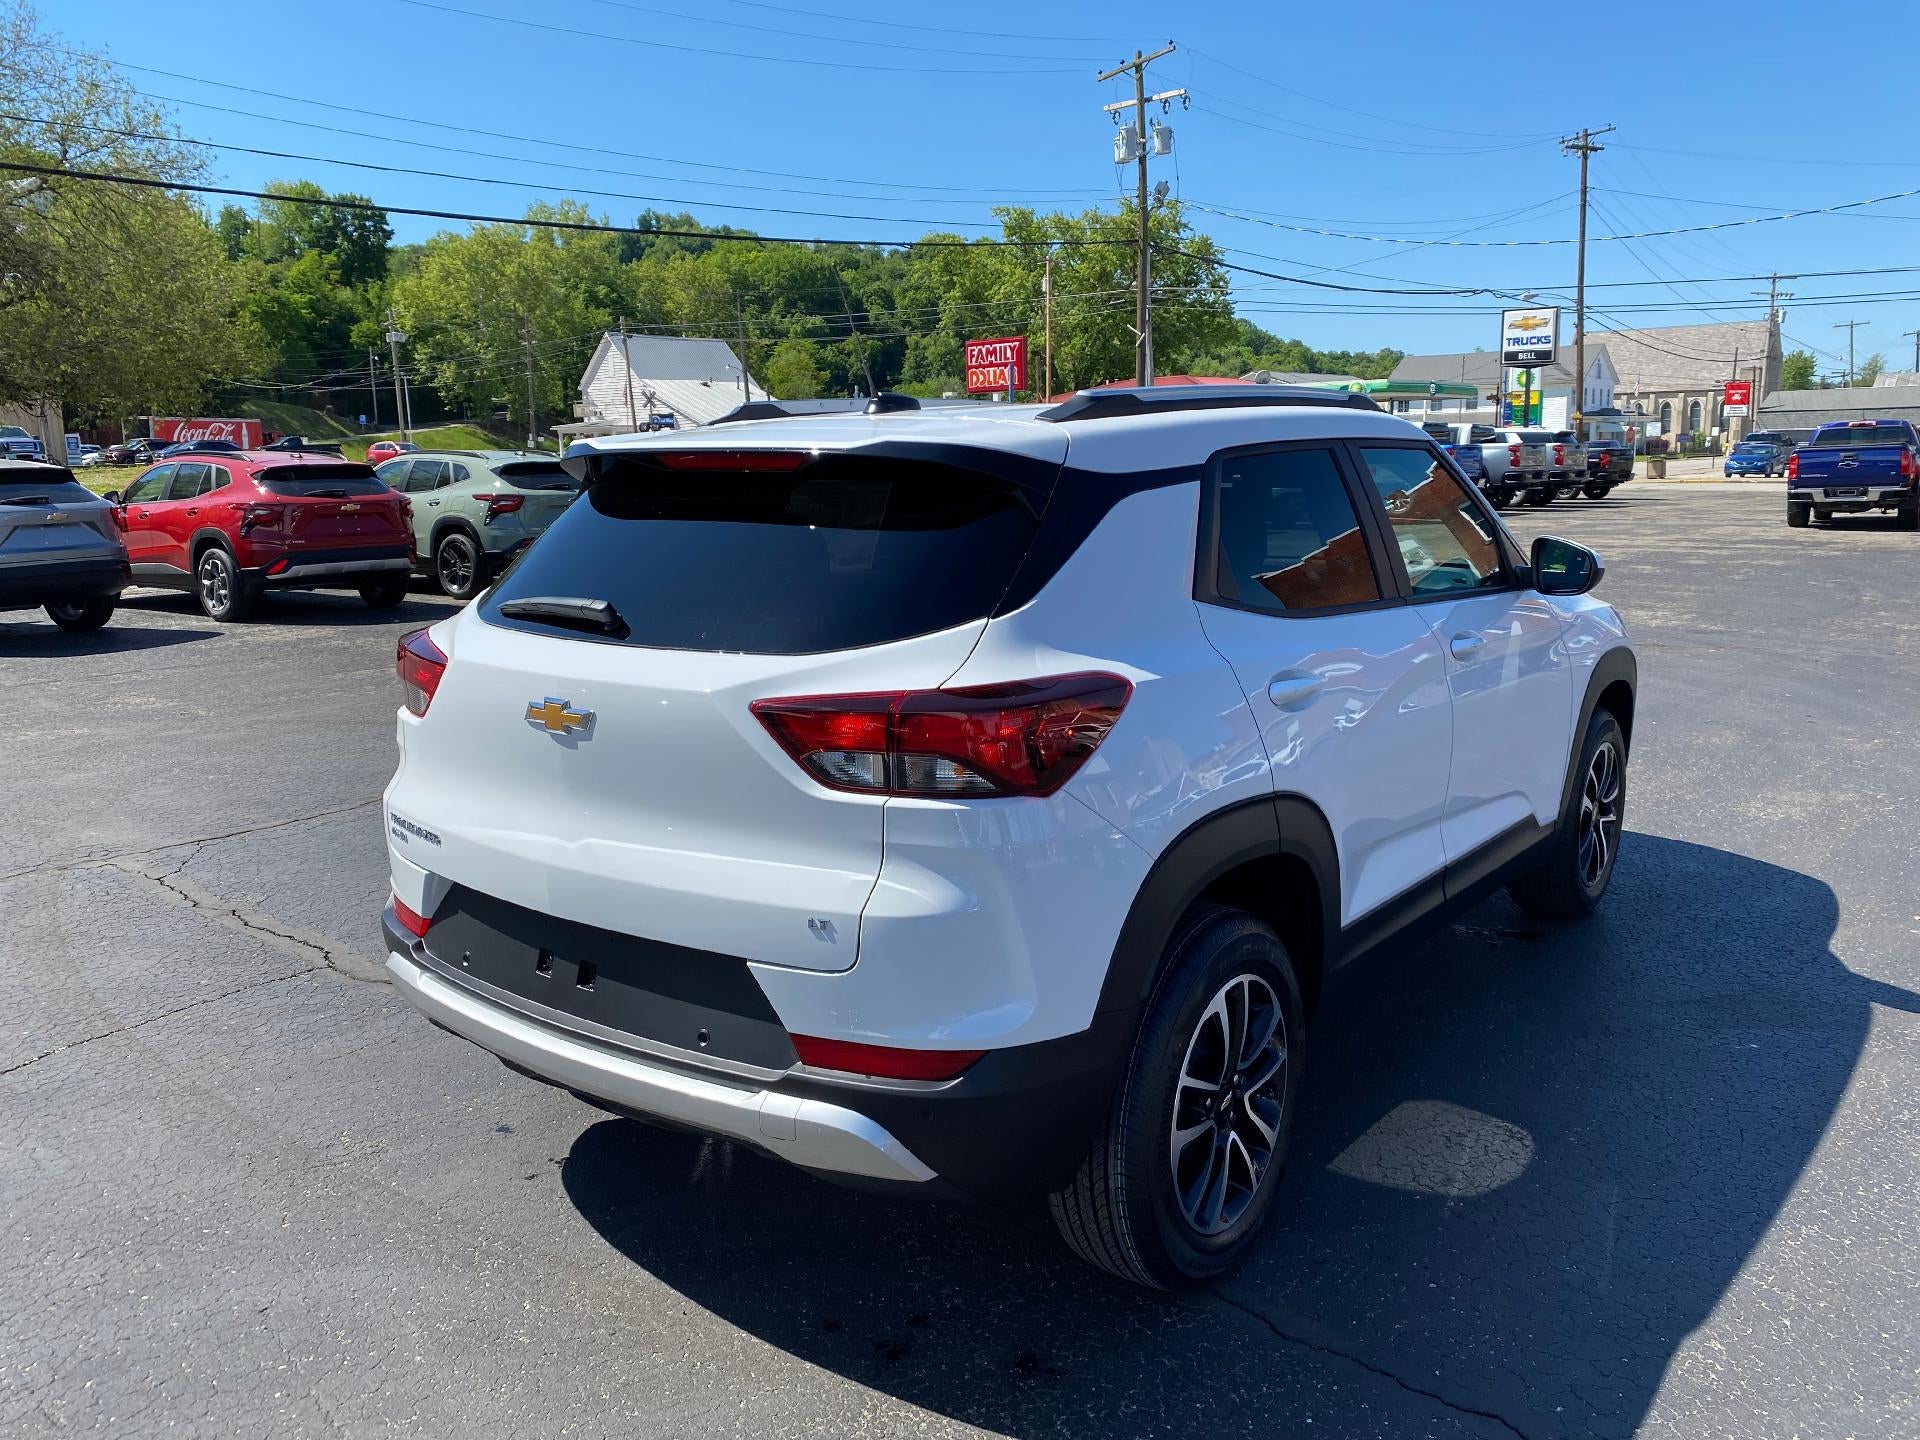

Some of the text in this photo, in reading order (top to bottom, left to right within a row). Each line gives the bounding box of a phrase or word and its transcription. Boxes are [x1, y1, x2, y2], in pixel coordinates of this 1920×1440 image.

[1505, 335, 1551, 347] TRUCKS
[967, 342, 1020, 365] FAMILY
[1518, 351, 1537, 360] BELL
